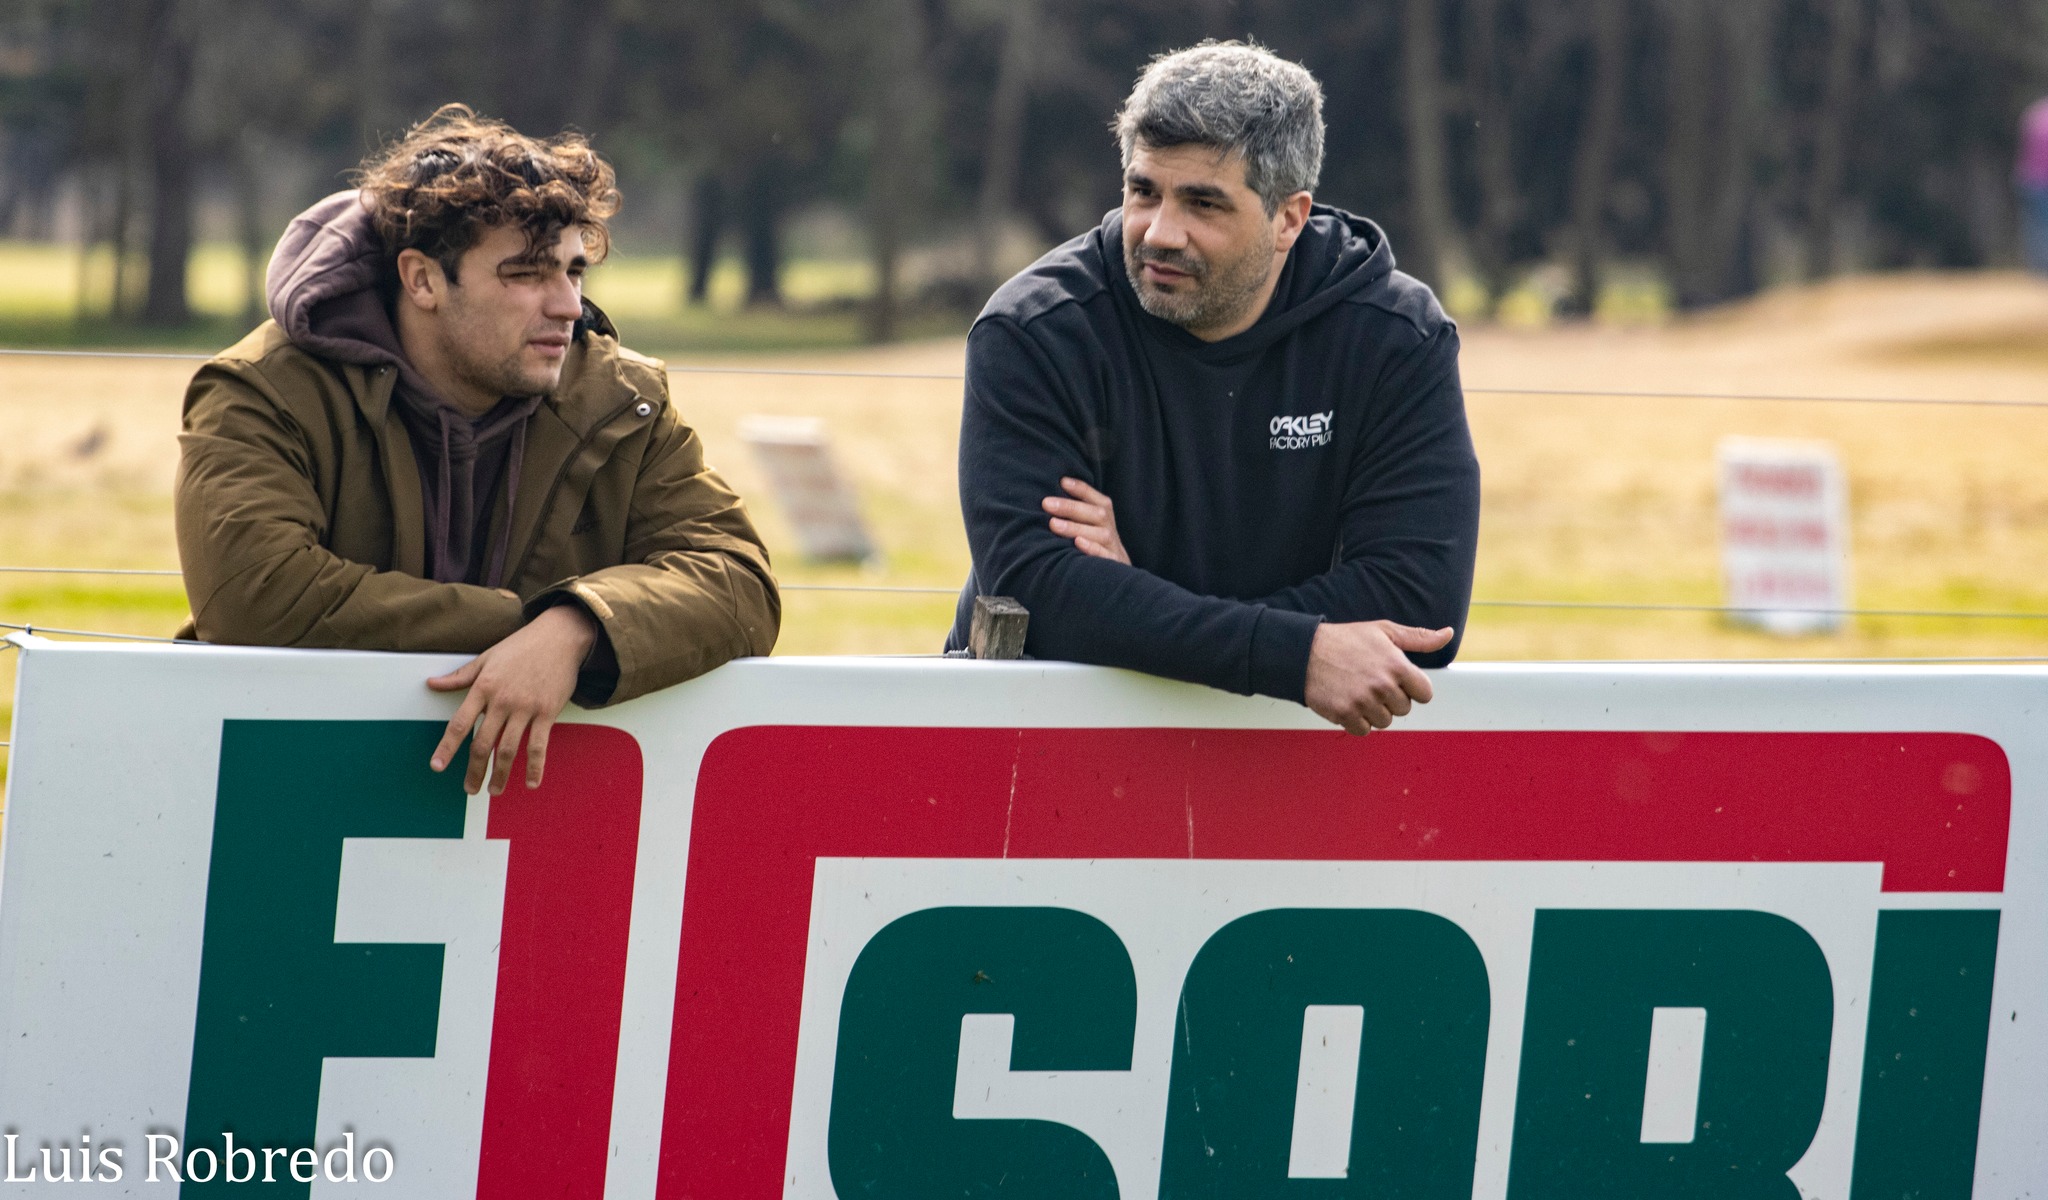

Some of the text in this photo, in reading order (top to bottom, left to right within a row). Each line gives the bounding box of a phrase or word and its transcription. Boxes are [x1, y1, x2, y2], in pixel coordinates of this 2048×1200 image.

[1269, 410, 1333, 435] OAKLEY
[1269, 430, 1333, 450] FACTORY PILOT
